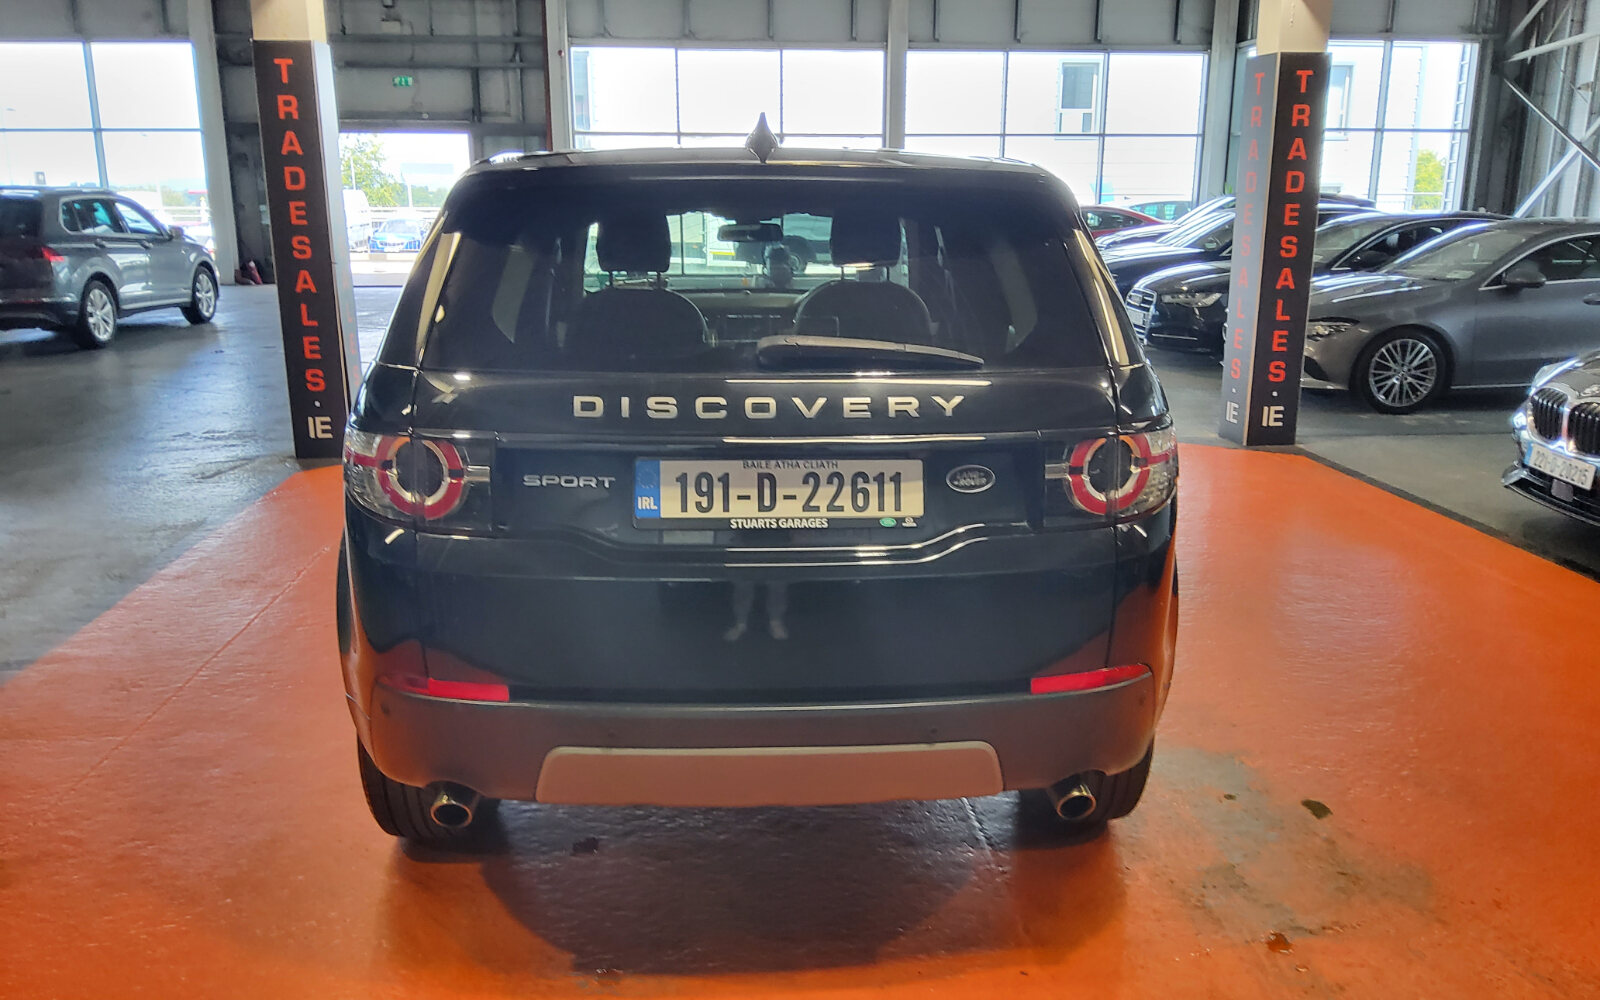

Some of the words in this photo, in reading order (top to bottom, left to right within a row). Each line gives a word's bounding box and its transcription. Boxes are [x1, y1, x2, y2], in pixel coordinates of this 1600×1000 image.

[573, 394, 965, 419] DISCOVERY
[743, 460, 771, 469] BAILE
[803, 460, 839, 469] CLIATH
[523, 474, 616, 489] SPORT
[675, 471, 902, 513] 191-D-22611
[637, 496, 658, 510] IRL
[730, 518, 777, 529] STUARTS
[779, 518, 829, 529] GARAGES
